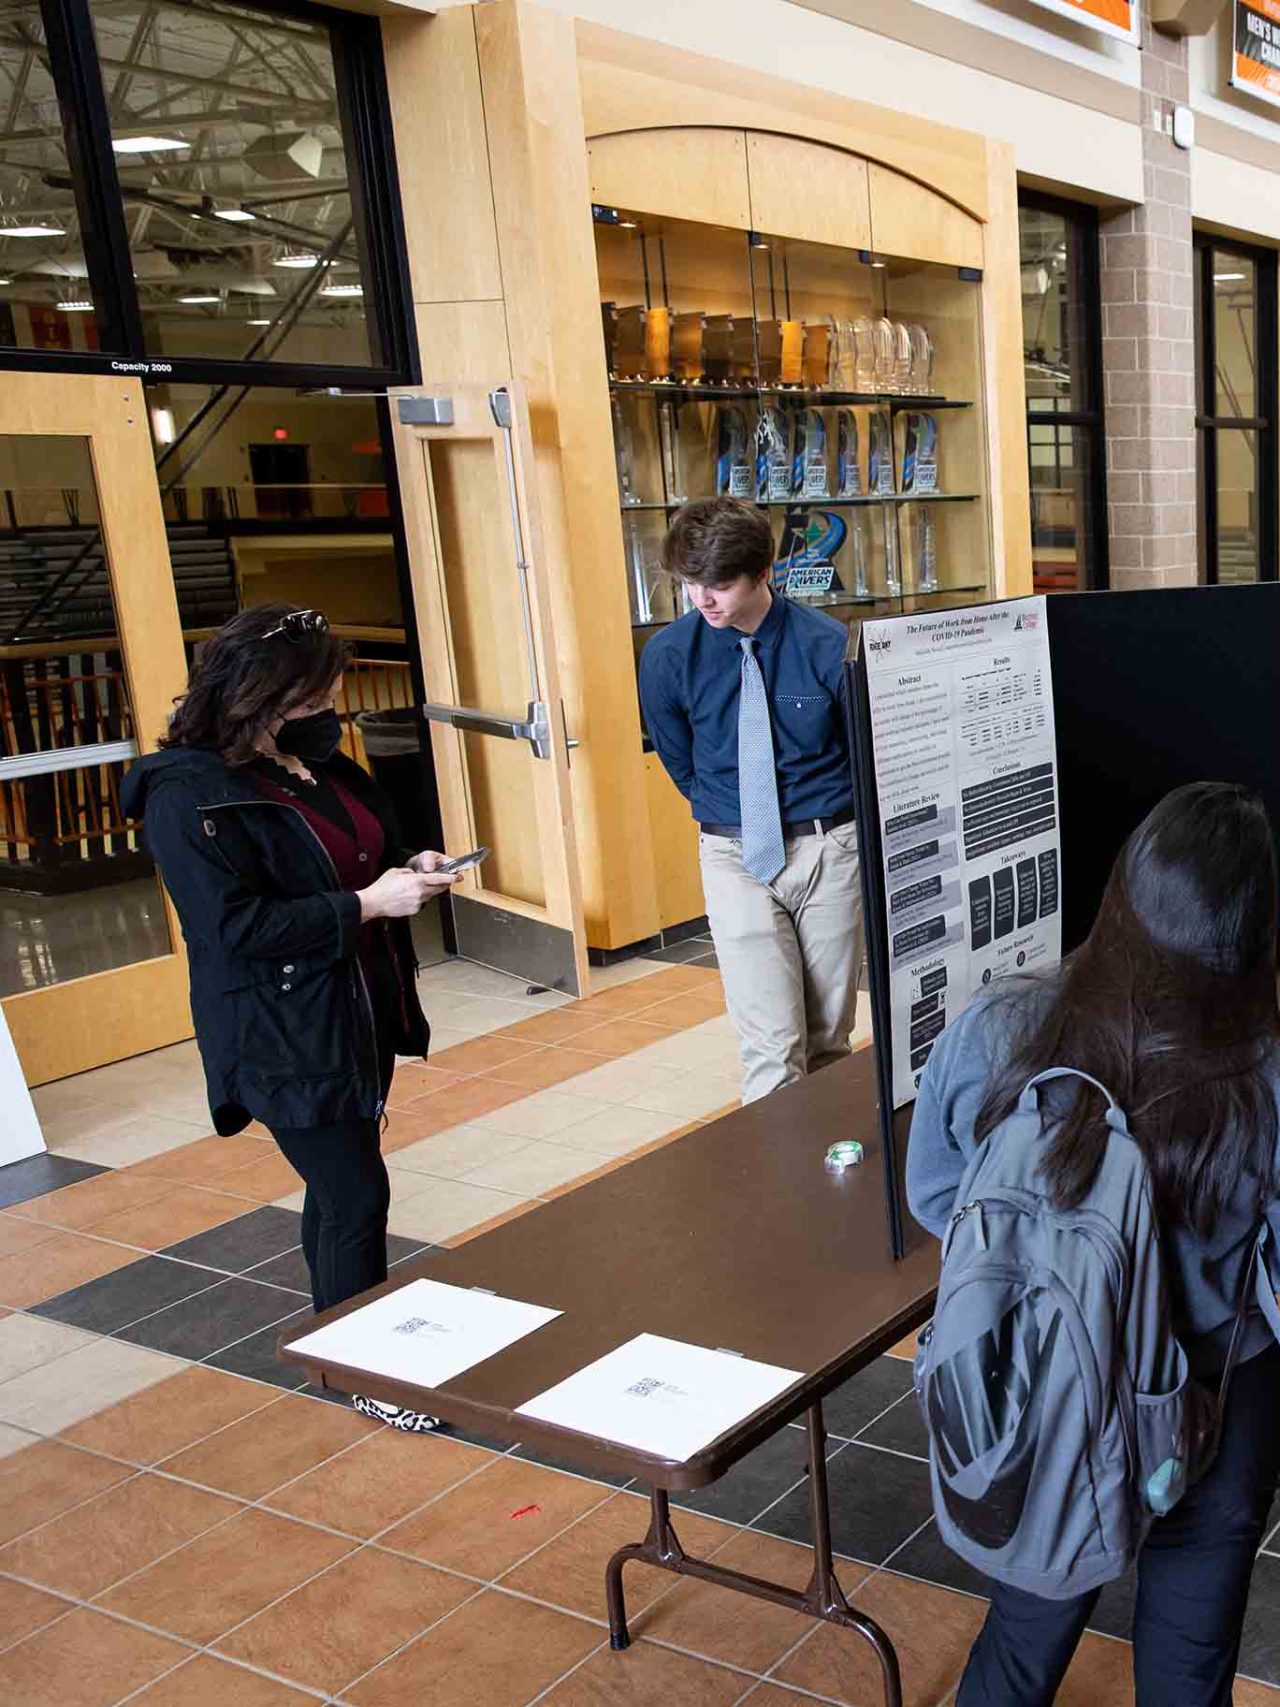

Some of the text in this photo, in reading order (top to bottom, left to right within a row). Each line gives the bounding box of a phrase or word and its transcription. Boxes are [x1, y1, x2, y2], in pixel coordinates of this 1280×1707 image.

[1247, 12, 1271, 43] MEN'S
[111, 361, 172, 372] Capacity 2000
[791, 568, 832, 576] AMERICAN
[907, 611, 1009, 635] The Future of Work from Home After the
[932, 627, 984, 642] COVID-19 Pandemic
[993, 657, 1010, 666] Results
[898, 675, 921, 686] Abstract
[893, 792, 940, 814] Literature Review
[911, 957, 945, 978] Methodology
